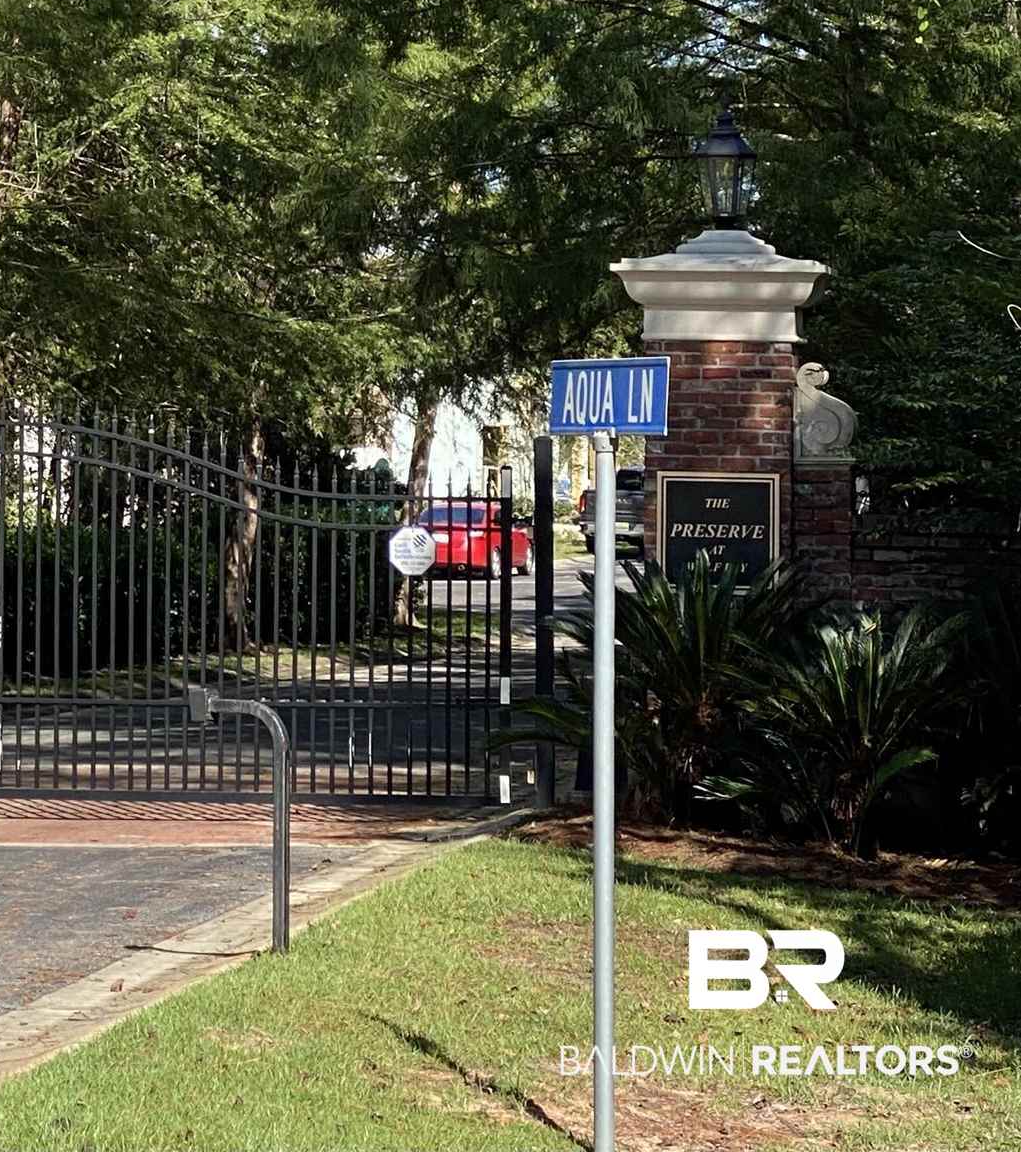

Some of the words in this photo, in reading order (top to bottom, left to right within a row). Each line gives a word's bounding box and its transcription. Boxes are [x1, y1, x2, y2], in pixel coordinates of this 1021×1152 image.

[562, 370, 615, 425] AQUA
[628, 369, 654, 423] LN
[705, 498, 731, 509] THE
[670, 523, 765, 539] PRESERVE
[709, 545, 726, 555] AT
